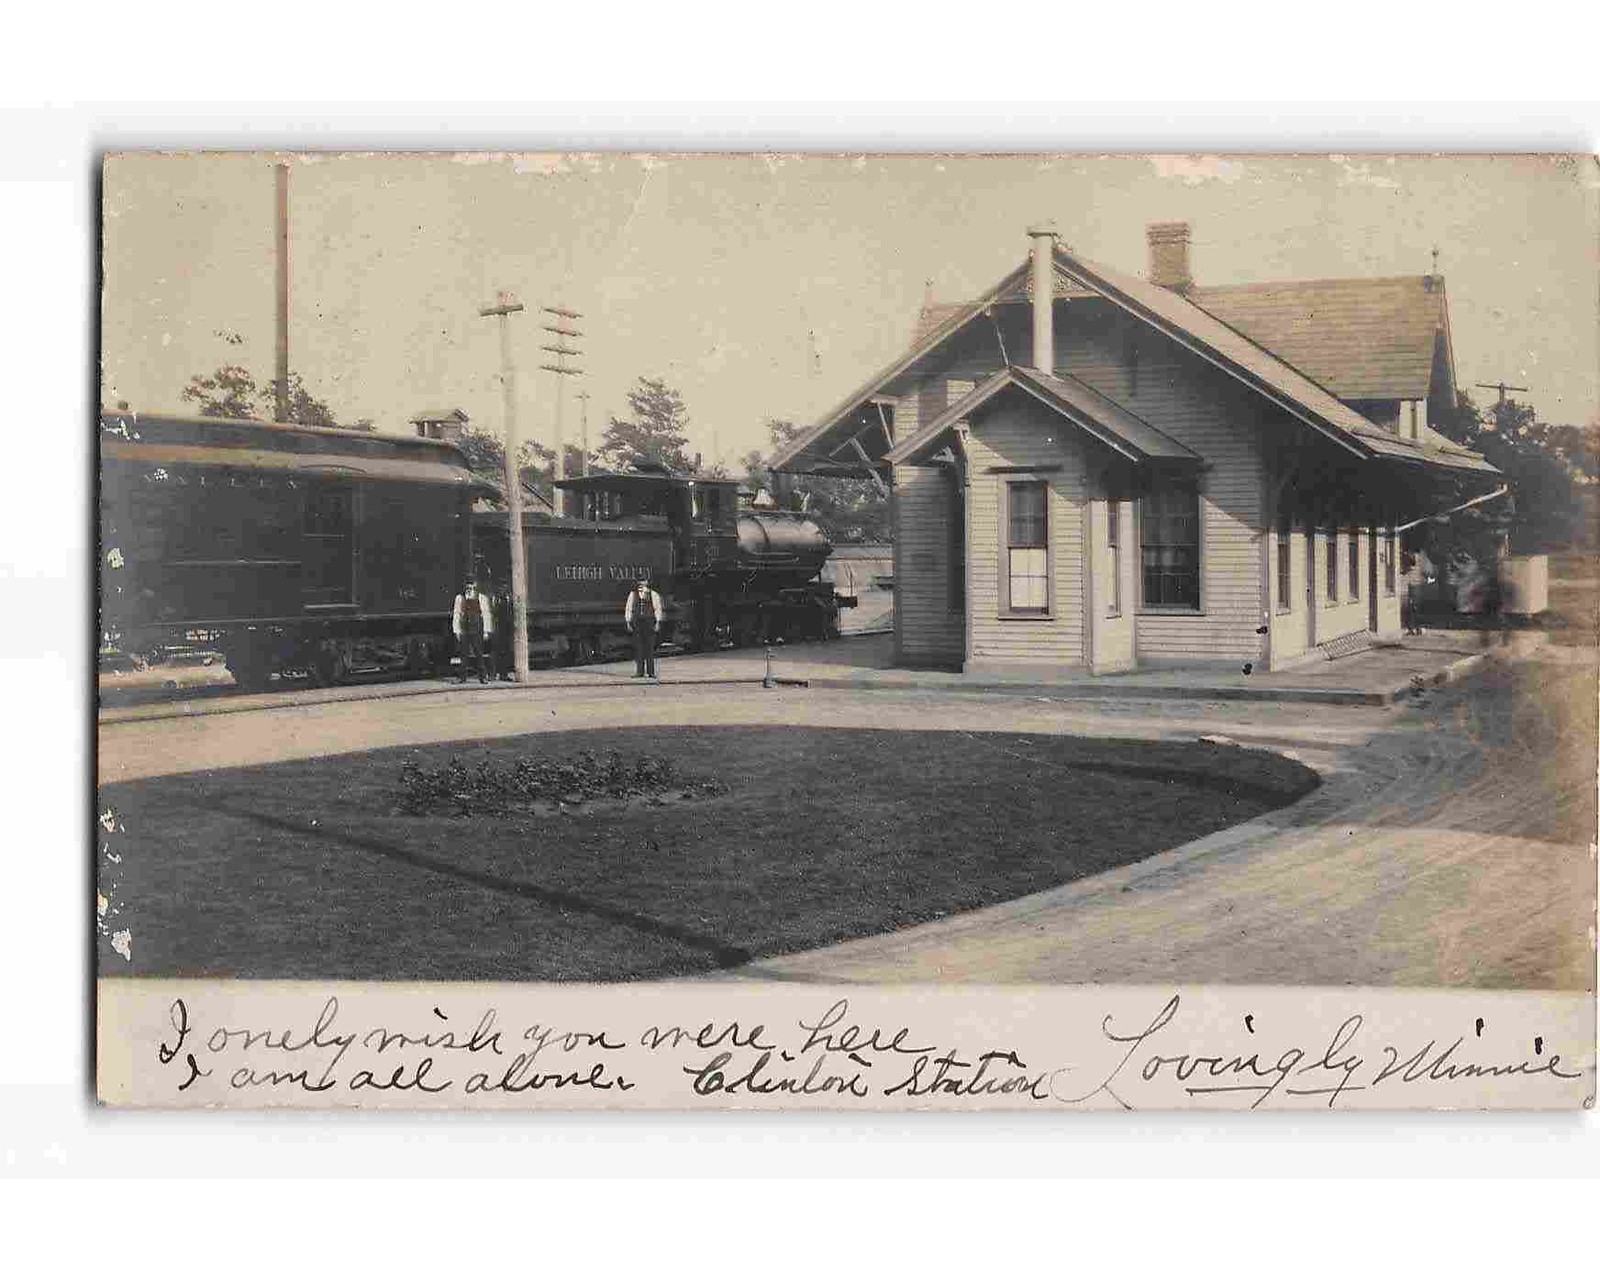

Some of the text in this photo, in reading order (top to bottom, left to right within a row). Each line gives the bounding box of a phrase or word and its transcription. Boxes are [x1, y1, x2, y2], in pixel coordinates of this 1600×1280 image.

[555, 565, 602, 580] LEHIGH
[159, 998, 191, 1064] I
[363, 1006, 502, 1055] wish
[523, 1023, 626, 1083] you
[640, 1021, 777, 1050] were
[799, 998, 937, 1054] here
[230, 1067, 336, 1091] am
[349, 1057, 452, 1092] all
[683, 1051, 872, 1098] Clinton
[884, 1048, 1050, 1100] Station
[1090, 994, 1582, 1109] Lovingly Minnie
